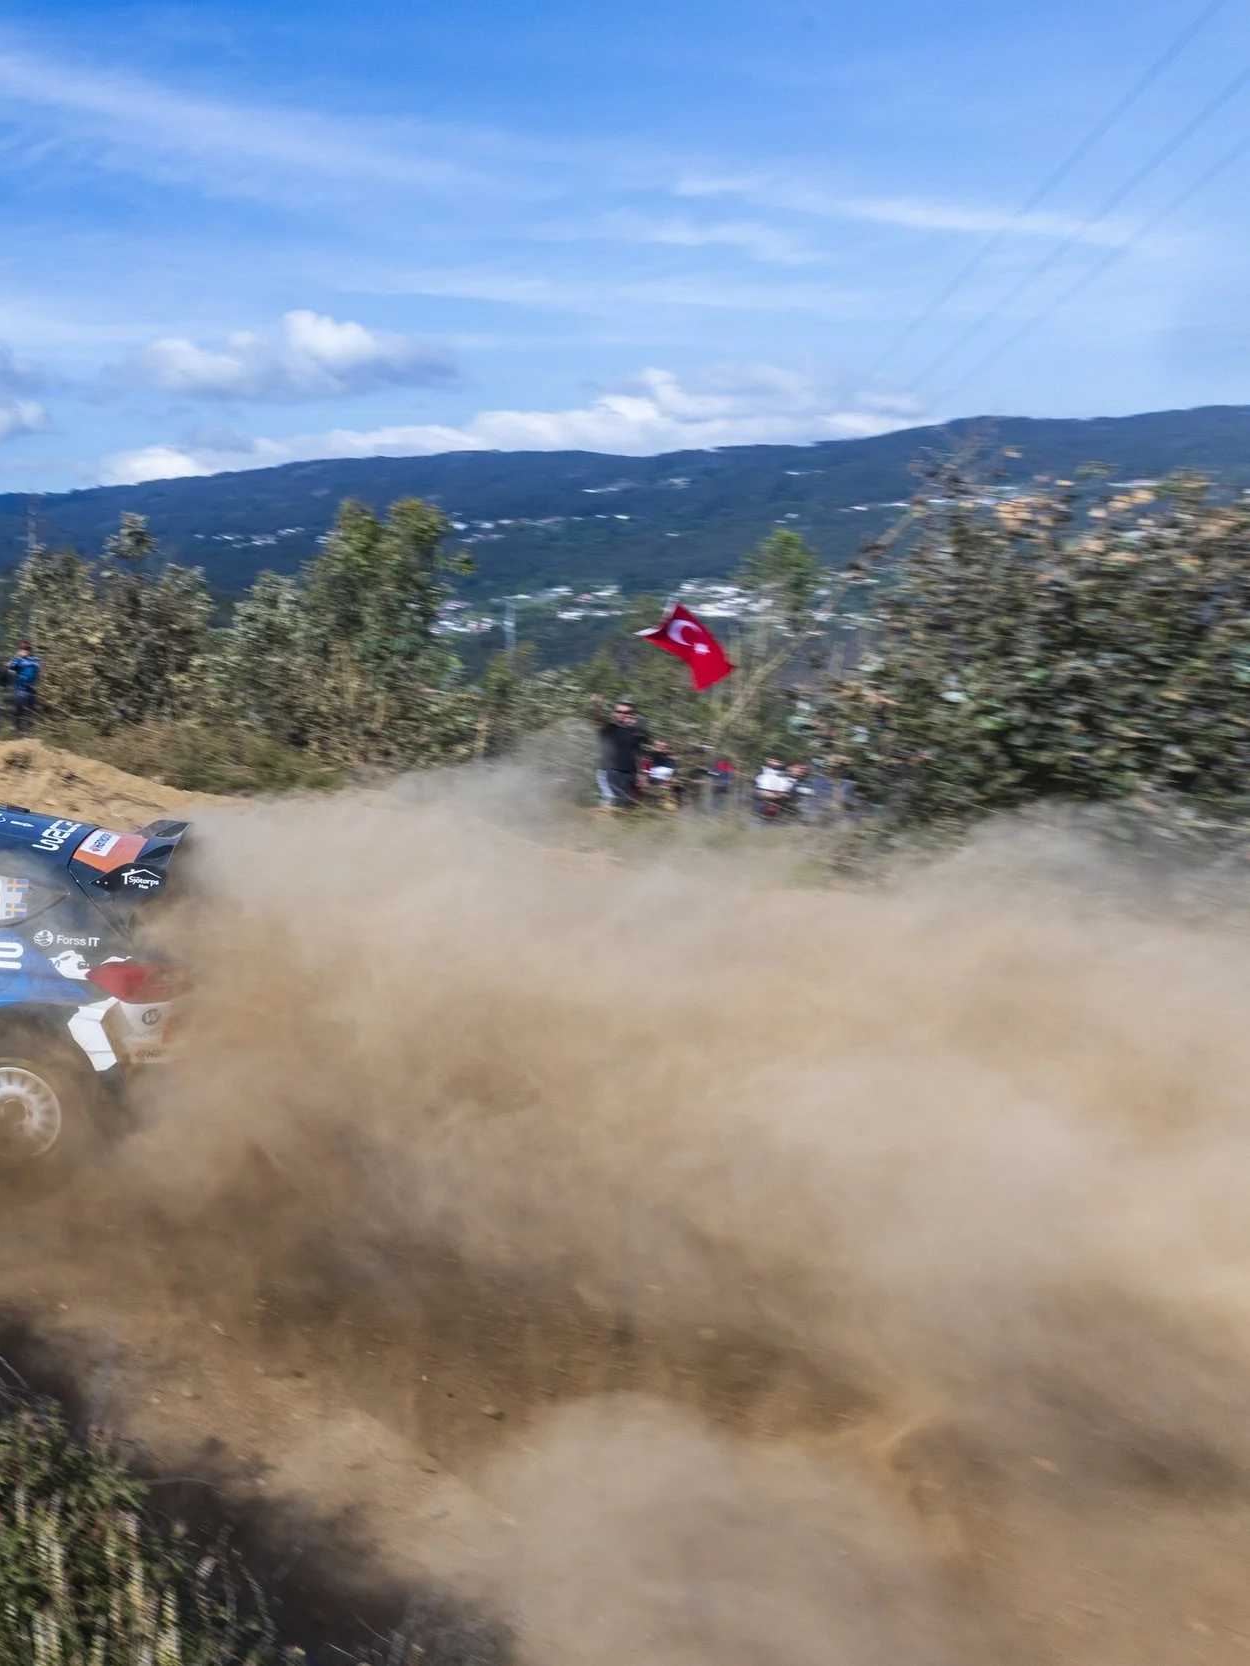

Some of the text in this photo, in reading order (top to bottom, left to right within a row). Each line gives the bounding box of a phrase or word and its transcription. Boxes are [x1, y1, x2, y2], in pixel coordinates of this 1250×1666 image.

[128, 875, 160, 887] Sjötorps
[56, 934, 100, 947] Forss IT
